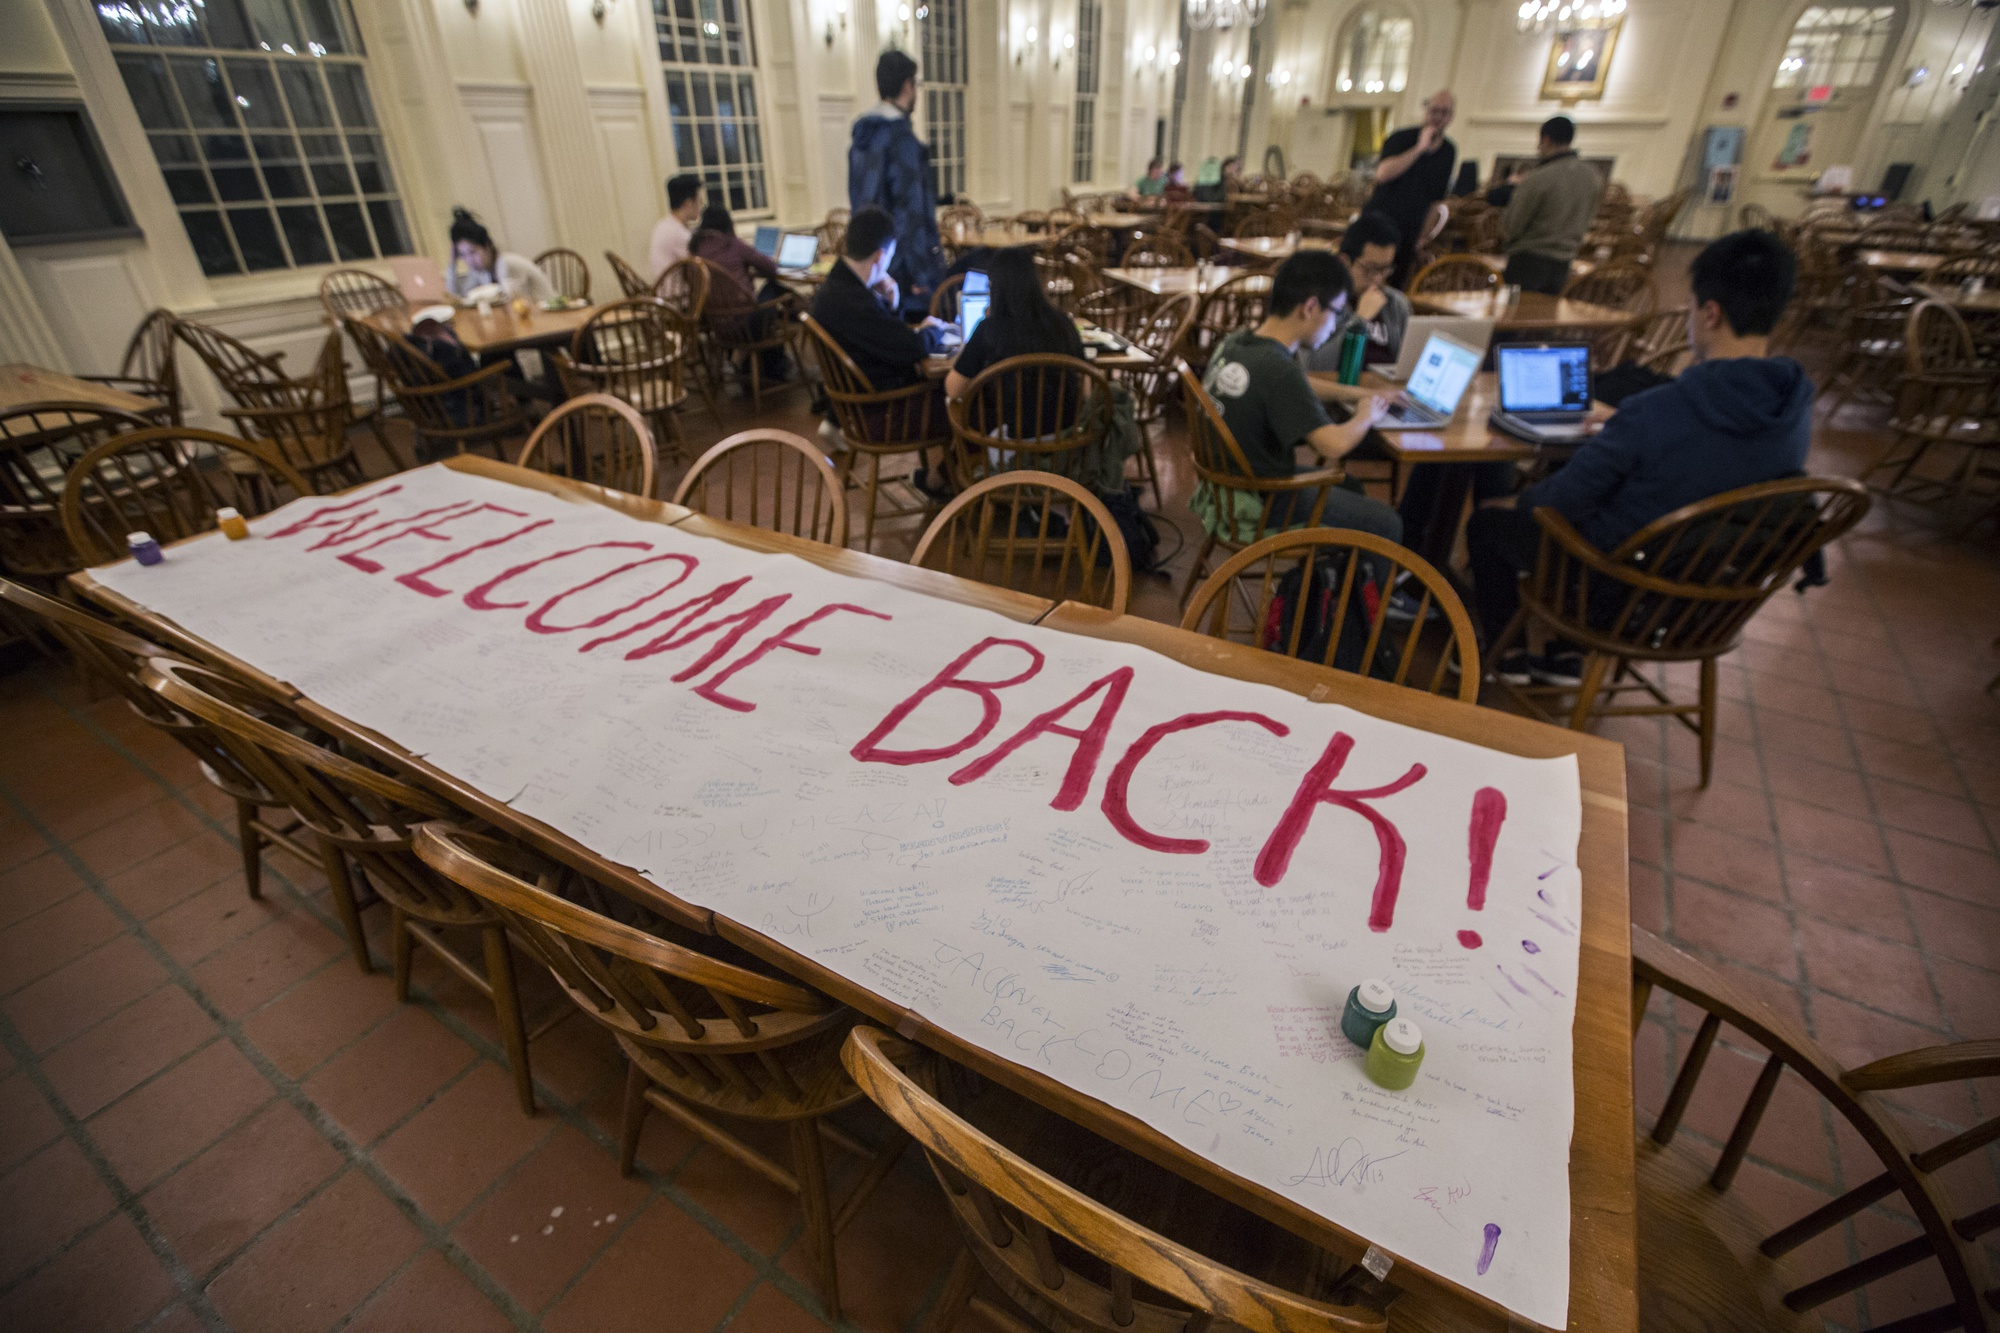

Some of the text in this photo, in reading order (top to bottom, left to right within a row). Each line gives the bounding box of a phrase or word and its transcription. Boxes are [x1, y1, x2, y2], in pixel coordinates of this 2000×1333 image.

[266, 485, 1507, 950] WELCOME BACK!
[740, 817, 768, 840] U
[1225, 1079, 1262, 1096] missed
